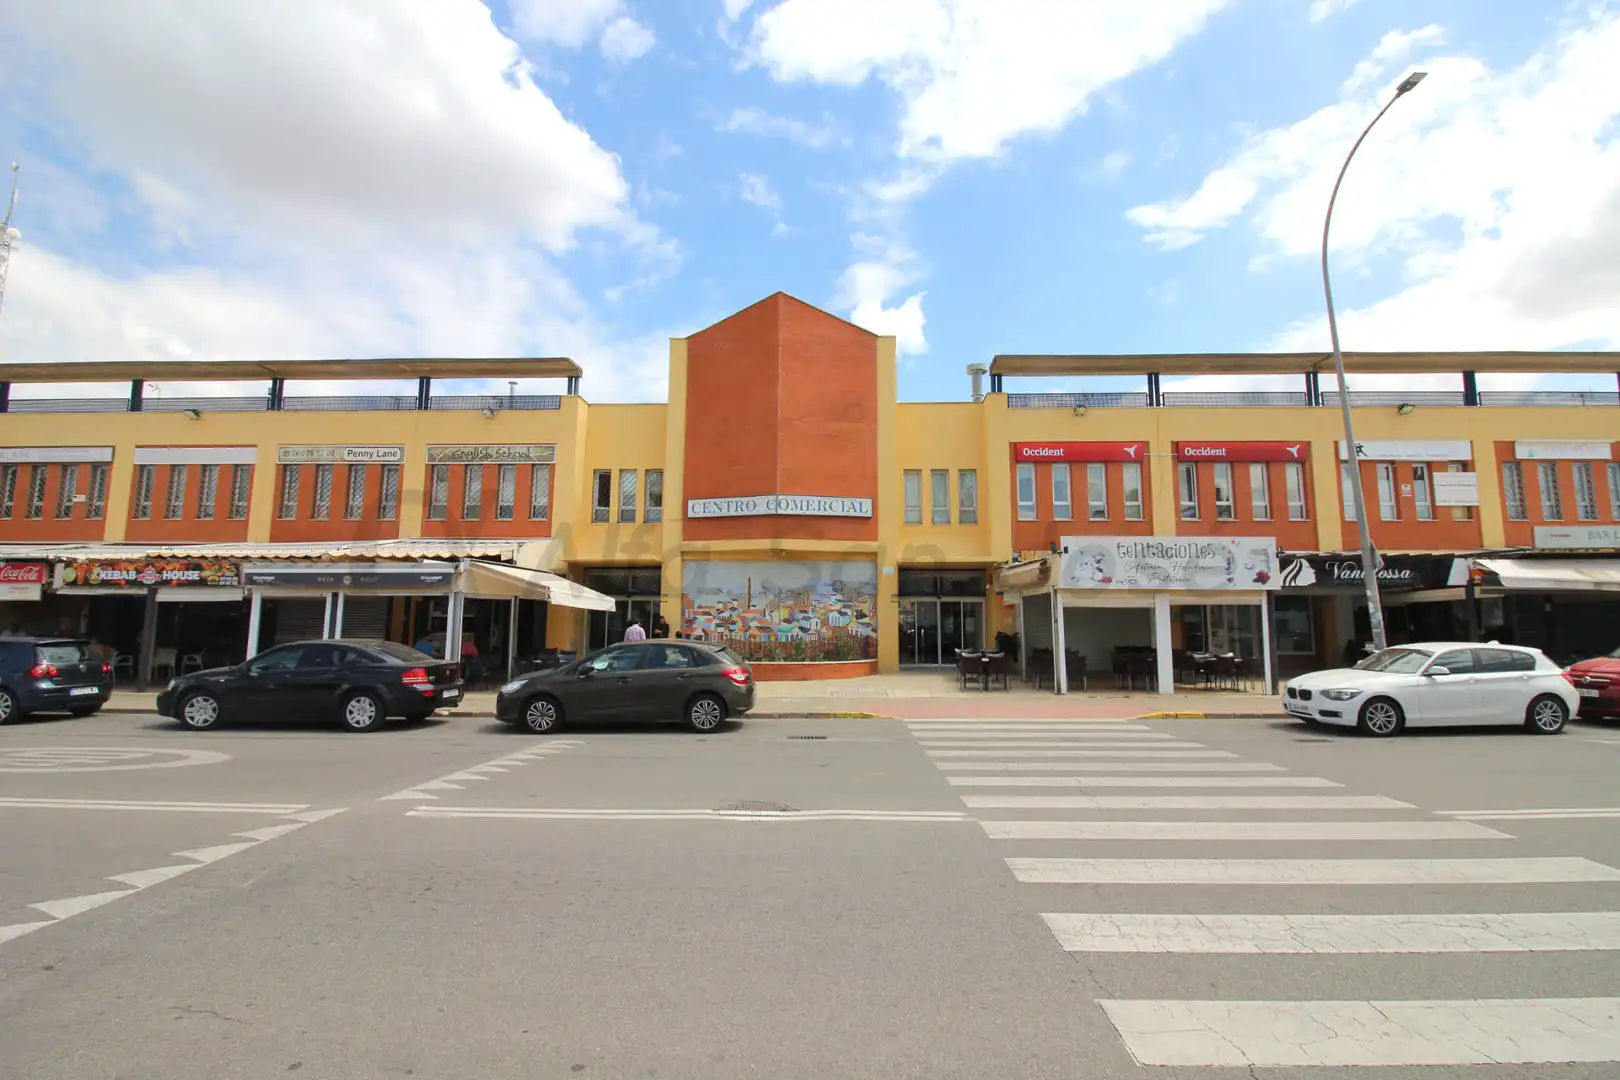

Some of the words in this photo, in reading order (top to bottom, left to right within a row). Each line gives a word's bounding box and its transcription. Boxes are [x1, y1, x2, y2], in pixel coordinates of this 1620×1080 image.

[347, 449, 374, 460] Penny
[376, 449, 398, 458] Lane
[452, 446, 492, 461] English
[1023, 447, 1064, 457] Occident
[1184, 447, 1227, 456] Occident
[691, 500, 757, 515] CENTRO
[766, 499, 869, 514] COMERCIAL
[1588, 530, 1610, 540] BAR
[1116, 542, 1216, 559] tentaciones
[100, 570, 137, 580] KEBAB
[162, 570, 200, 580] HOUSE
